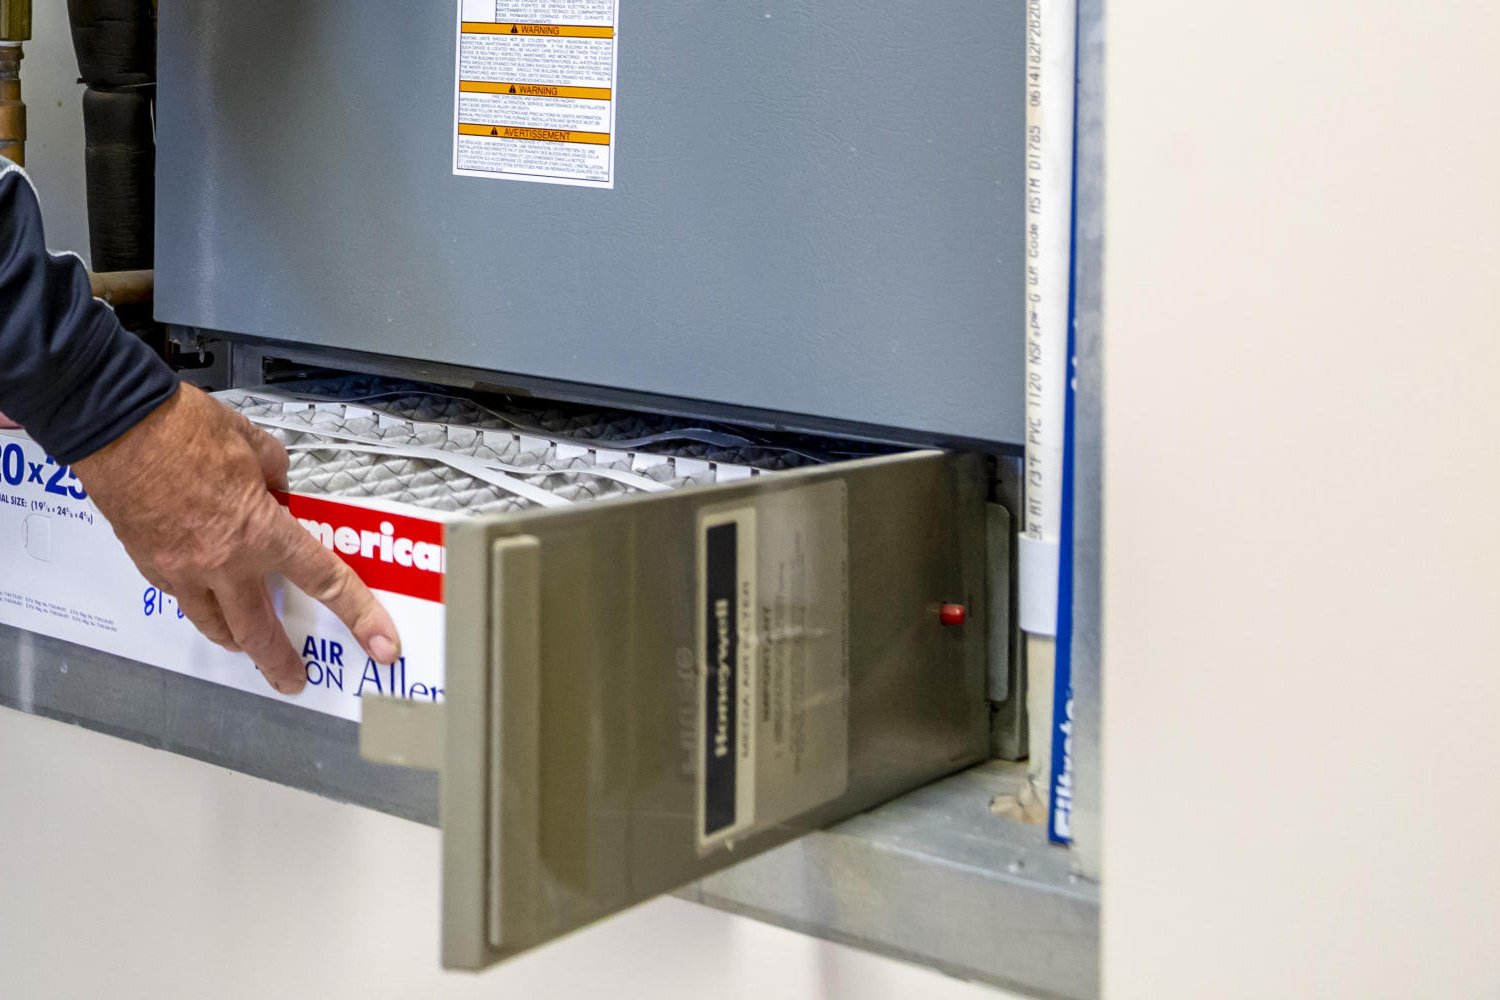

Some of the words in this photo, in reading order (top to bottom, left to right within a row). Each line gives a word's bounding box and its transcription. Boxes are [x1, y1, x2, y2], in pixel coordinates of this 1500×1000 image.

[520, 24, 560, 36] WARNING
[518, 84, 559, 97] WARNING
[504, 128, 571, 141] AVERTISSEMENT
[1028, 373, 1042, 408] 1120
[1028, 418, 1042, 446] PVC
[10, 495, 28, 508] SIZE:
[298, 518, 446, 574] merica
[302, 635, 344, 667] AIR
[714, 598, 732, 758] Honeywell
